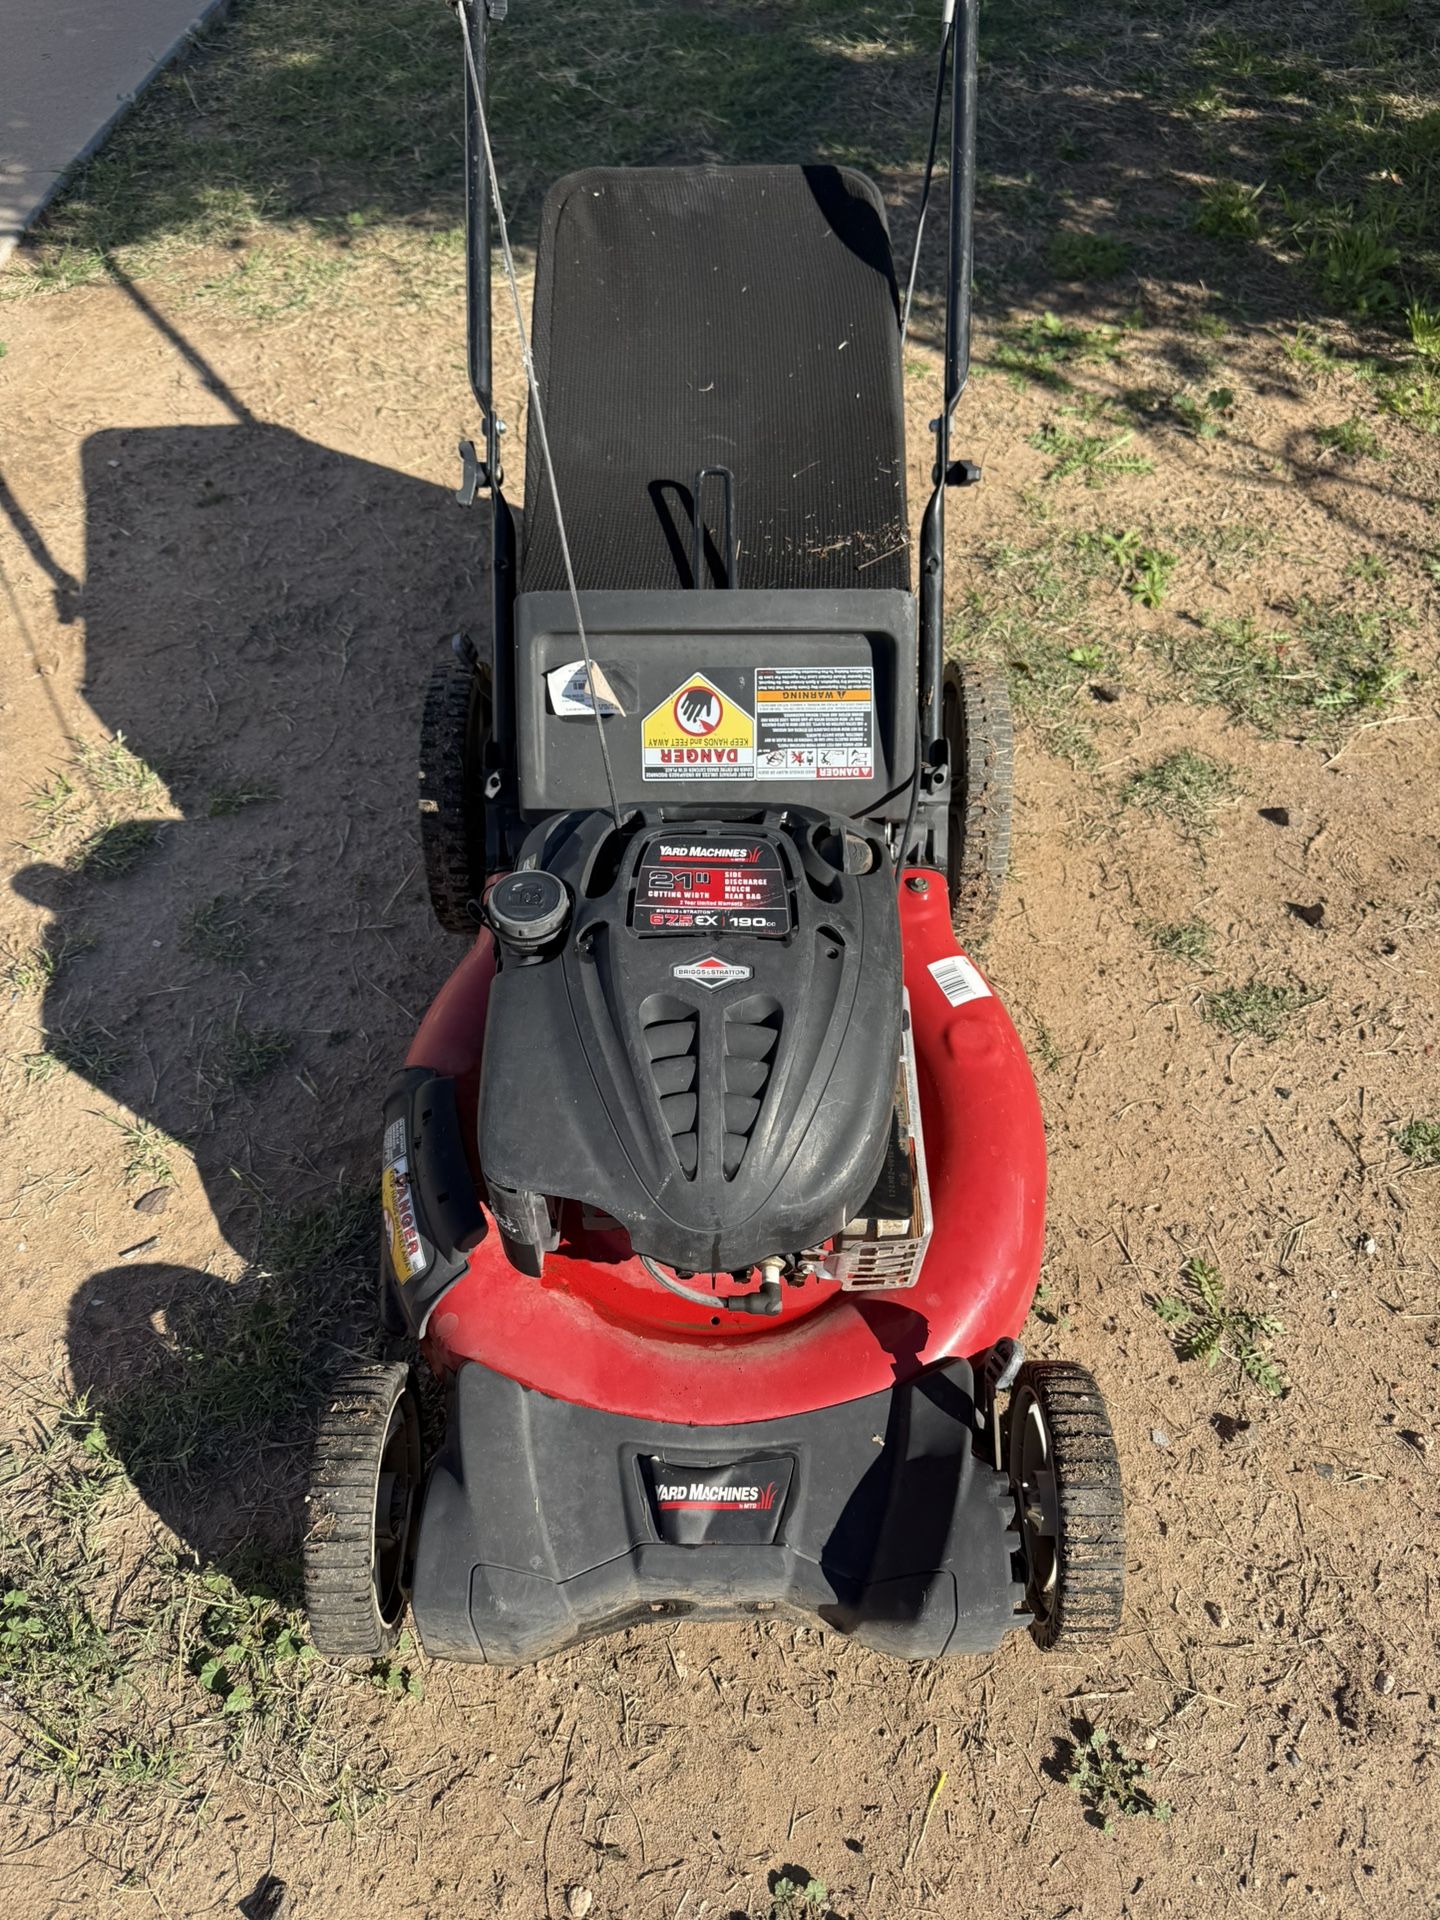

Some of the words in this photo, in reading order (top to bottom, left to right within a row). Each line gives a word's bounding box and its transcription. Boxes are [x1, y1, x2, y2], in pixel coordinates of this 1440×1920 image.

[690, 738, 703, 746] and
[704, 738, 728, 746] HANDS
[730, 738, 748, 746] KEEP
[660, 749, 738, 763] DANGER
[820, 768, 859, 776] DANGER
[660, 846, 688, 856] YARD
[689, 847, 747, 857] MACHINES
[649, 871, 709, 889] 21"
[650, 914, 693, 925] 675
[695, 915, 718, 926] EX
[655, 1484, 687, 1500] YARD
[689, 1483, 759, 1501] MACHINES
